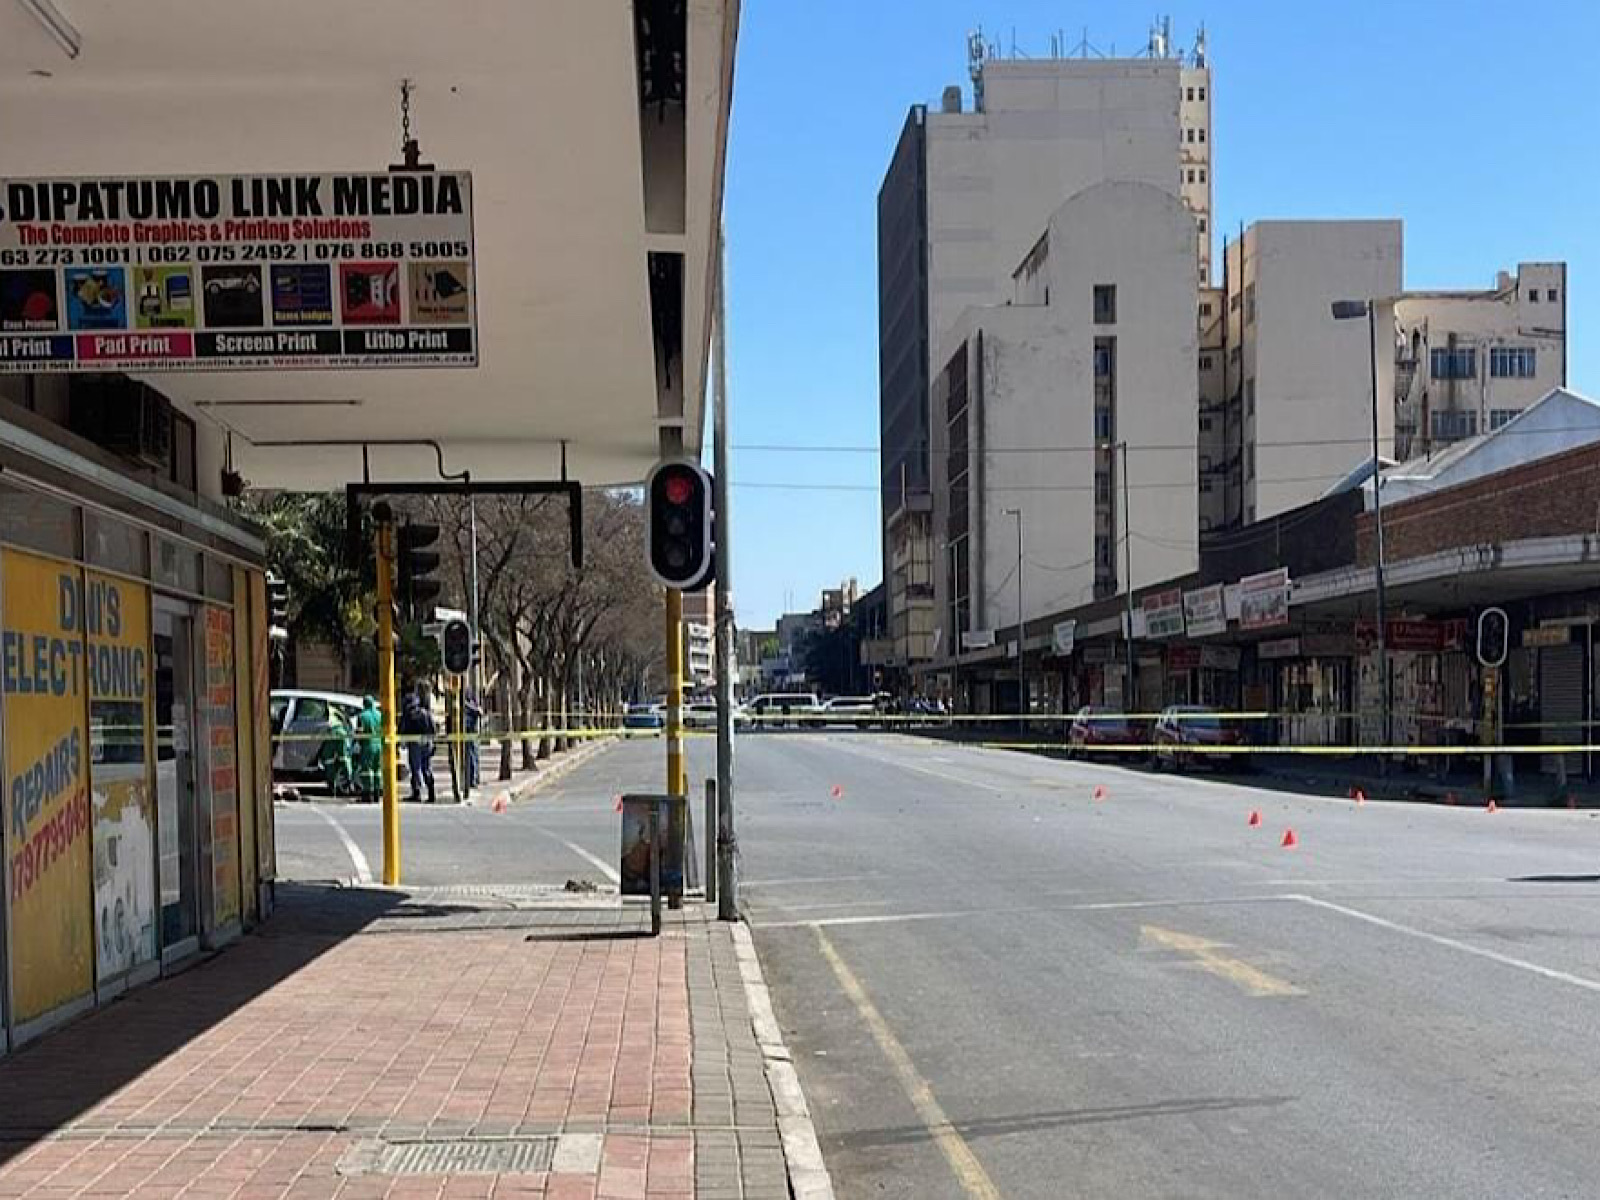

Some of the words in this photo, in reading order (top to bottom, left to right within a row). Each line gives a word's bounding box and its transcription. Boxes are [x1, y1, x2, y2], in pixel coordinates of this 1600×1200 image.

[8, 180, 219, 222] DIPATUMO
[231, 177, 323, 217] LINK
[332, 175, 464, 215] MEDIA
[16, 223, 48, 245] The
[51, 223, 130, 246] Complete
[133, 221, 206, 245] Graphics
[210, 223, 221, 242] &
[224, 219, 290, 242] Printing
[291, 218, 371, 240] Solutions
[35, 248, 74, 265] 273
[79, 247, 130, 264] 1001
[148, 246, 190, 263] 062
[197, 245, 235, 262] 075
[241, 243, 297, 261] 2492
[314, 242, 354, 260] 076
[360, 241, 403, 259] 868
[409, 240, 468, 259] 5005
[12, 338, 52, 356] Print
[95, 336, 126, 355] Pad
[129, 335, 171, 354] Print
[215, 334, 275, 352] Screen
[276, 333, 317, 351] Print
[364, 331, 405, 350] Litho
[408, 330, 449, 349] Print
[12, 725, 80, 844] REPAIRS
